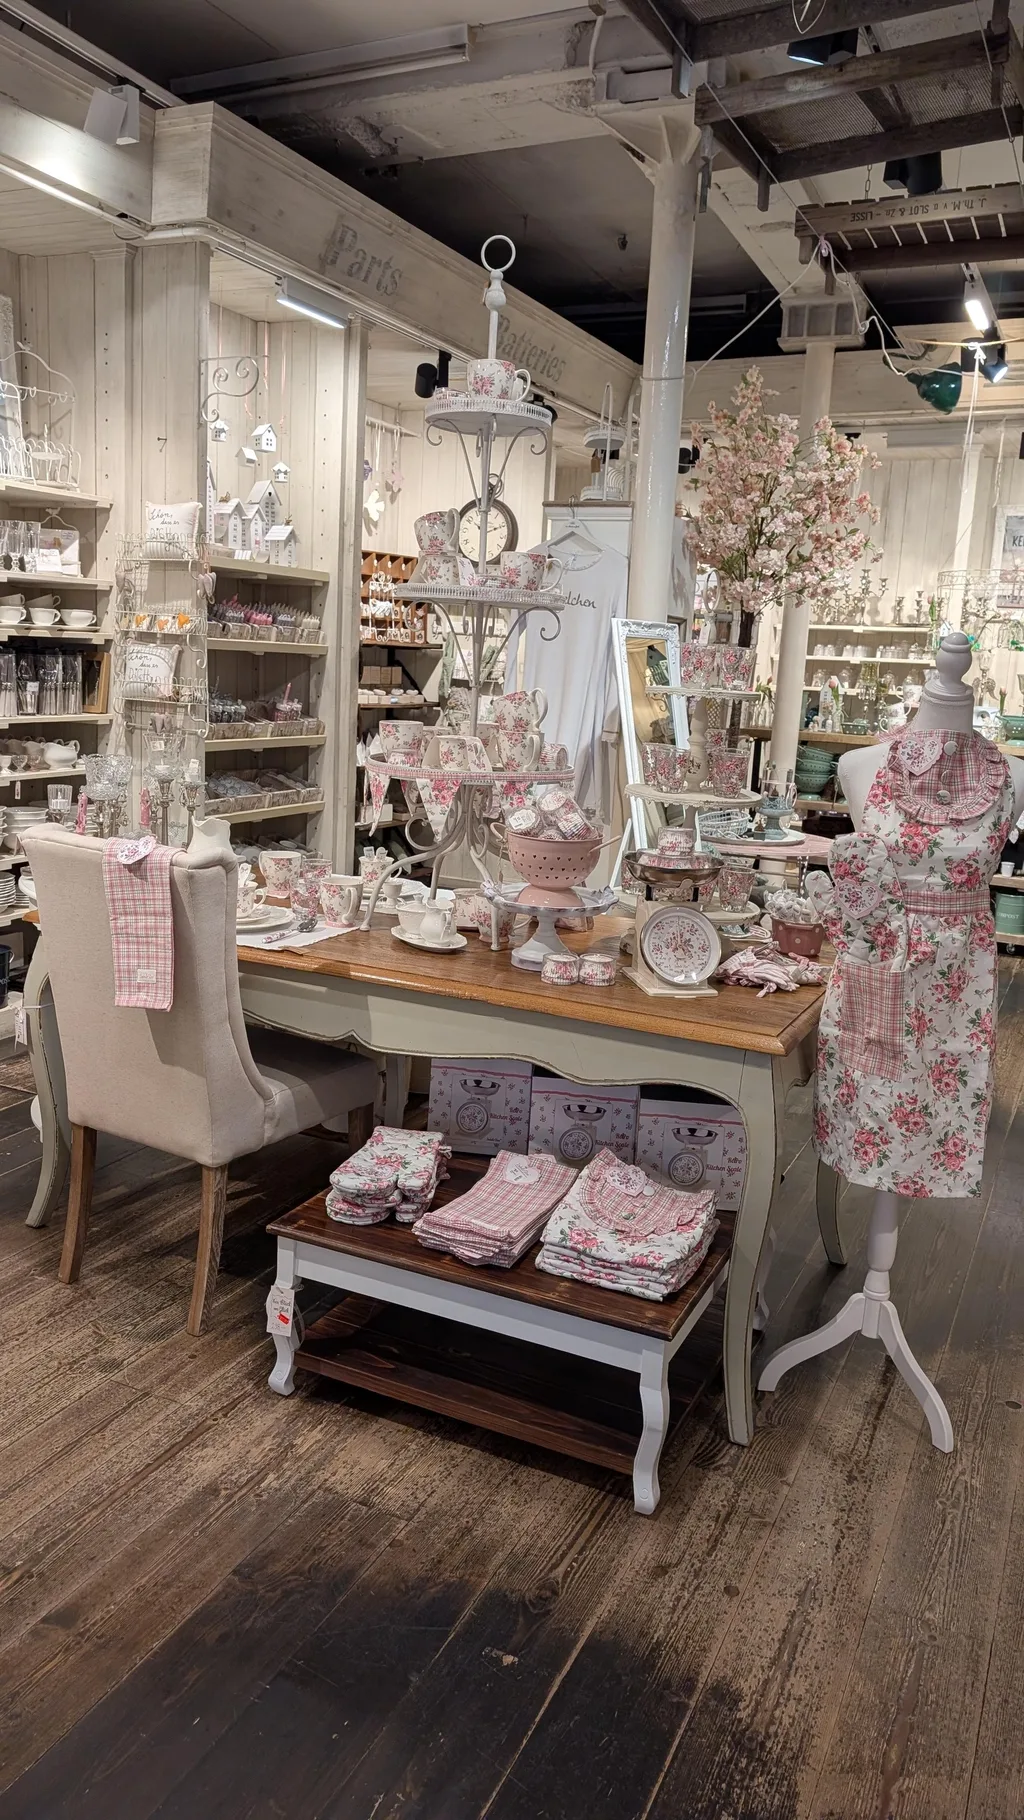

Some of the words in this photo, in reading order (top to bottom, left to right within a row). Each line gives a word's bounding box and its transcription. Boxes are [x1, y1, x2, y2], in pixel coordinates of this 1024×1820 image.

[899, 208, 906, 216] &
[909, 204, 930, 216] SLOT
[850, 211, 873, 222] LISSE
[319, 223, 403, 296] Parts
[565, 591, 597, 609] lchen
[705, 1164, 726, 1172] Kitchen
